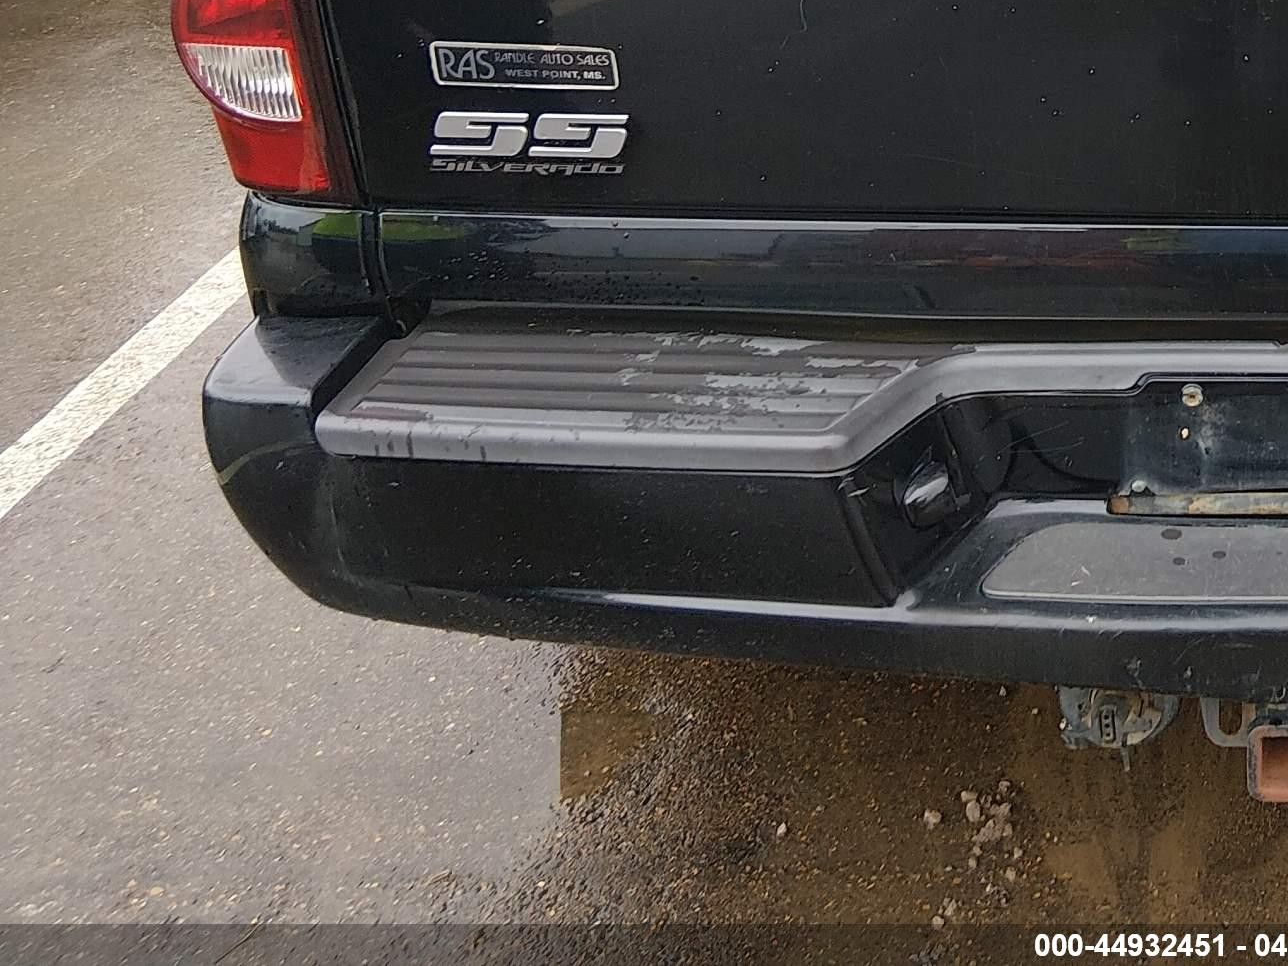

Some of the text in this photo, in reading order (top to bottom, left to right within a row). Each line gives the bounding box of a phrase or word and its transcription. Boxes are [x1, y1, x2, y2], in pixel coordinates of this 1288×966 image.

[438, 48, 496, 80] RAS
[494, 51, 610, 66] RANDLE AUTO SALES
[504, 68, 607, 81] WEST POINT, MS.
[429, 111, 630, 159] SS
[429, 158, 626, 176] SILVERADO
